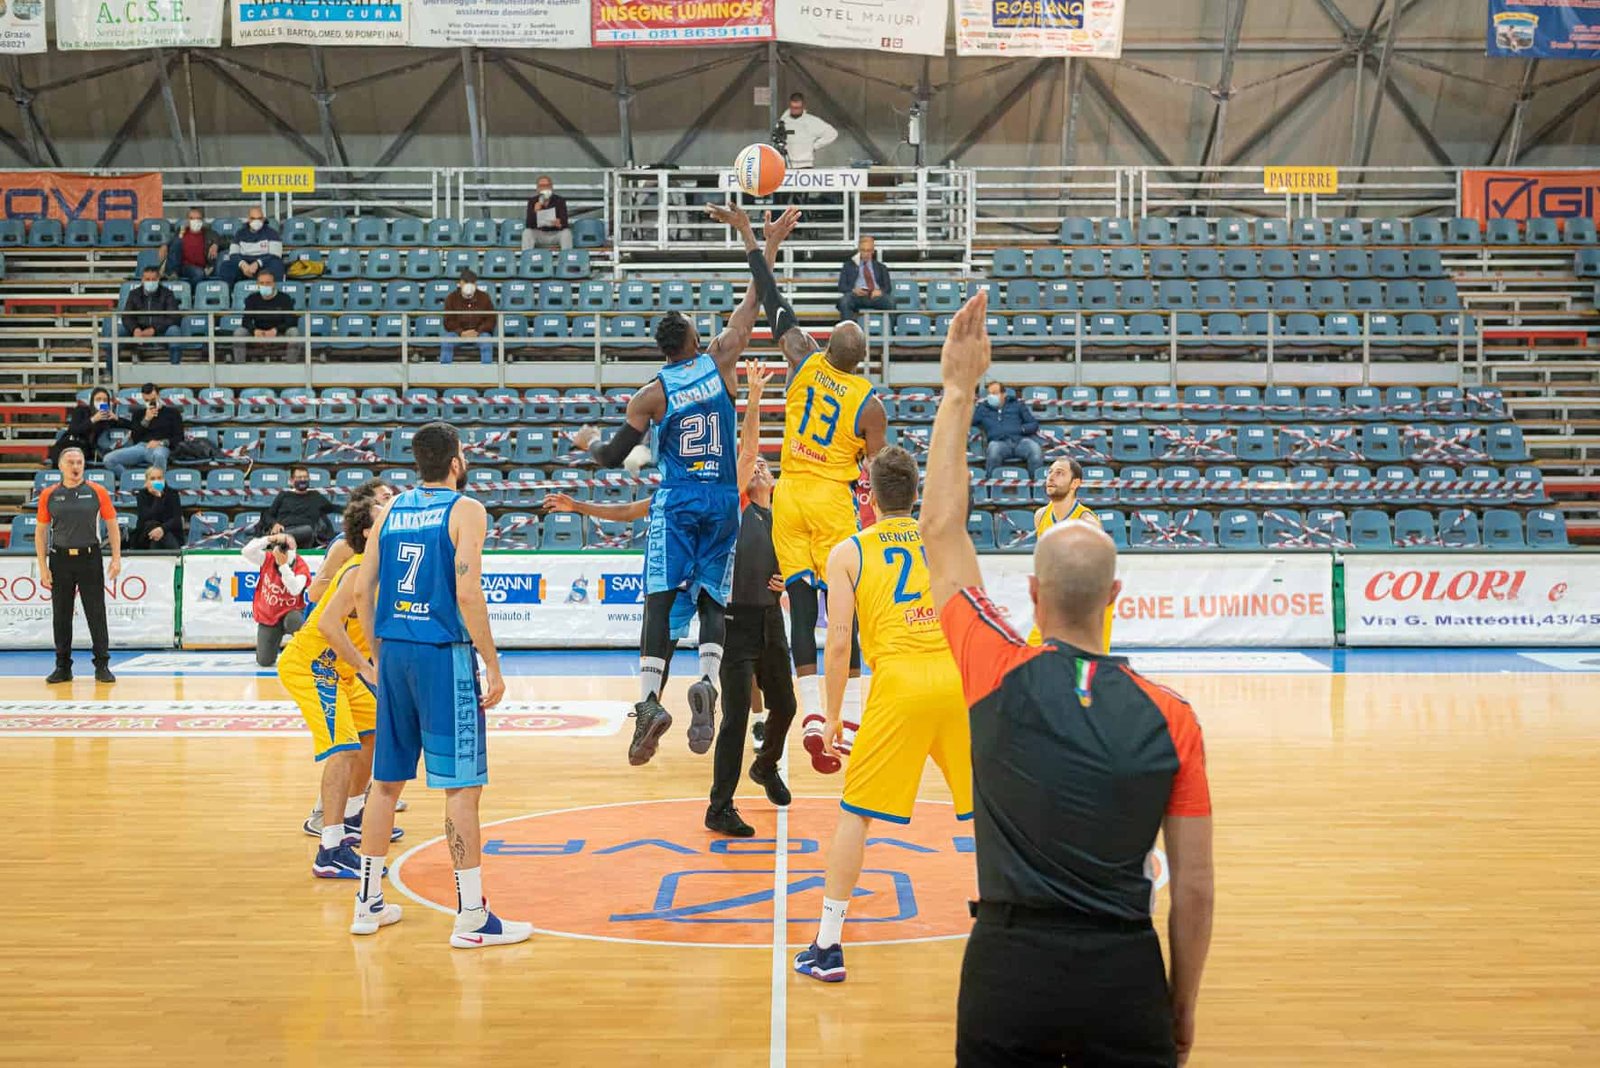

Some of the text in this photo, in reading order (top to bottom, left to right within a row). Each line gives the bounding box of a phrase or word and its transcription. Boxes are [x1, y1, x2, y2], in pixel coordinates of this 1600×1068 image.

[247, 7, 398, 18] CASA DI CURA
[601, 2, 763, 22] INSEGNE LUMINOSE
[800, 6, 920, 26] HOTEL MAIURI
[240, 30, 251, 38] VIA
[253, 28, 275, 37] COLLE
[611, 27, 761, 40] Tel. 081 8639141
[247, 173, 310, 187] PARTERRE
[728, 173, 860, 187] PZIONE TV
[1270, 172, 1332, 188] PARTERRE
[0, 188, 138, 222] OVA
[1539, 186, 1600, 219] GI
[814, 370, 848, 397] THOMAS
[798, 386, 841, 446] 13
[679, 412, 722, 456] 21
[397, 542, 425, 594] 7
[0, 576, 147, 602] ROSNO
[481, 576, 532, 591] OVANNI
[612, 576, 644, 591] SAN
[1364, 570, 1568, 602] COLORI e
[483, 590, 507, 603] TO
[410, 603, 430, 613] GLS
[915, 607, 934, 618] Ko
[1113, 593, 1324, 620] GNE LUMINOSE
[608, 613, 642, 621] www.sa
[1361, 615, 1397, 626] Via
[1405, 615, 1427, 626] G.
[456, 678, 475, 763] BASKET
[482, 838, 977, 856] IVOVA
